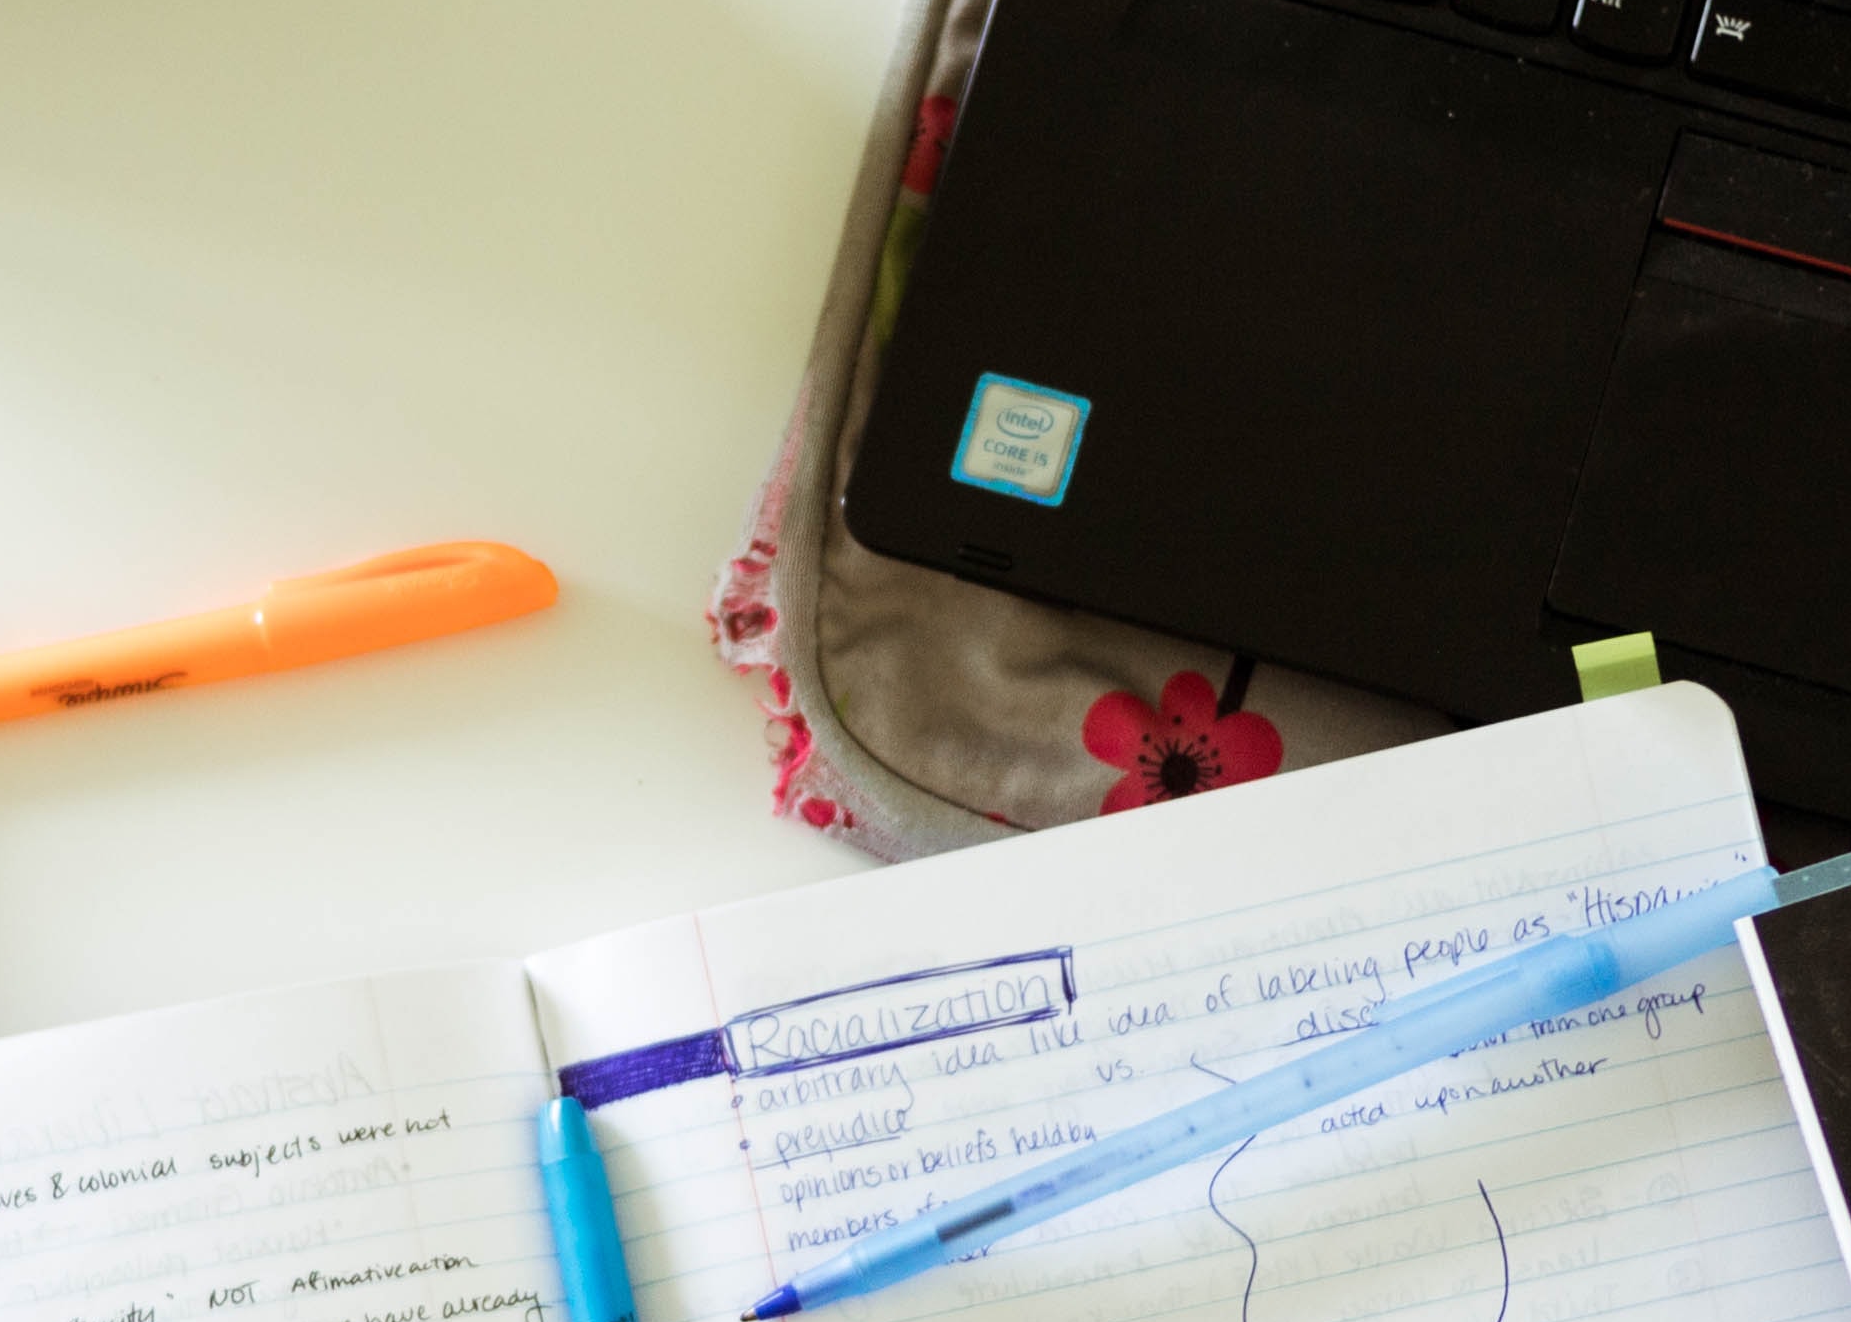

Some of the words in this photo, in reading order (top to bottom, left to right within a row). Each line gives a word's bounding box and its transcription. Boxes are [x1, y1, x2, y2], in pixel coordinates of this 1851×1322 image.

[1004, 408, 1046, 432] intel
[983, 438, 1029, 463] CORE
[748, 972, 1053, 1064] Racialization
[932, 1040, 1000, 1074] idea
[1030, 1022, 1083, 1056] like
[1107, 995, 1177, 1038] idea
[1206, 977, 1234, 1012] of
[1256, 955, 1388, 1021] labeling
[1403, 928, 1492, 978] people
[1512, 915, 1550, 943] as
[775, 1107, 908, 1165] prejudice
